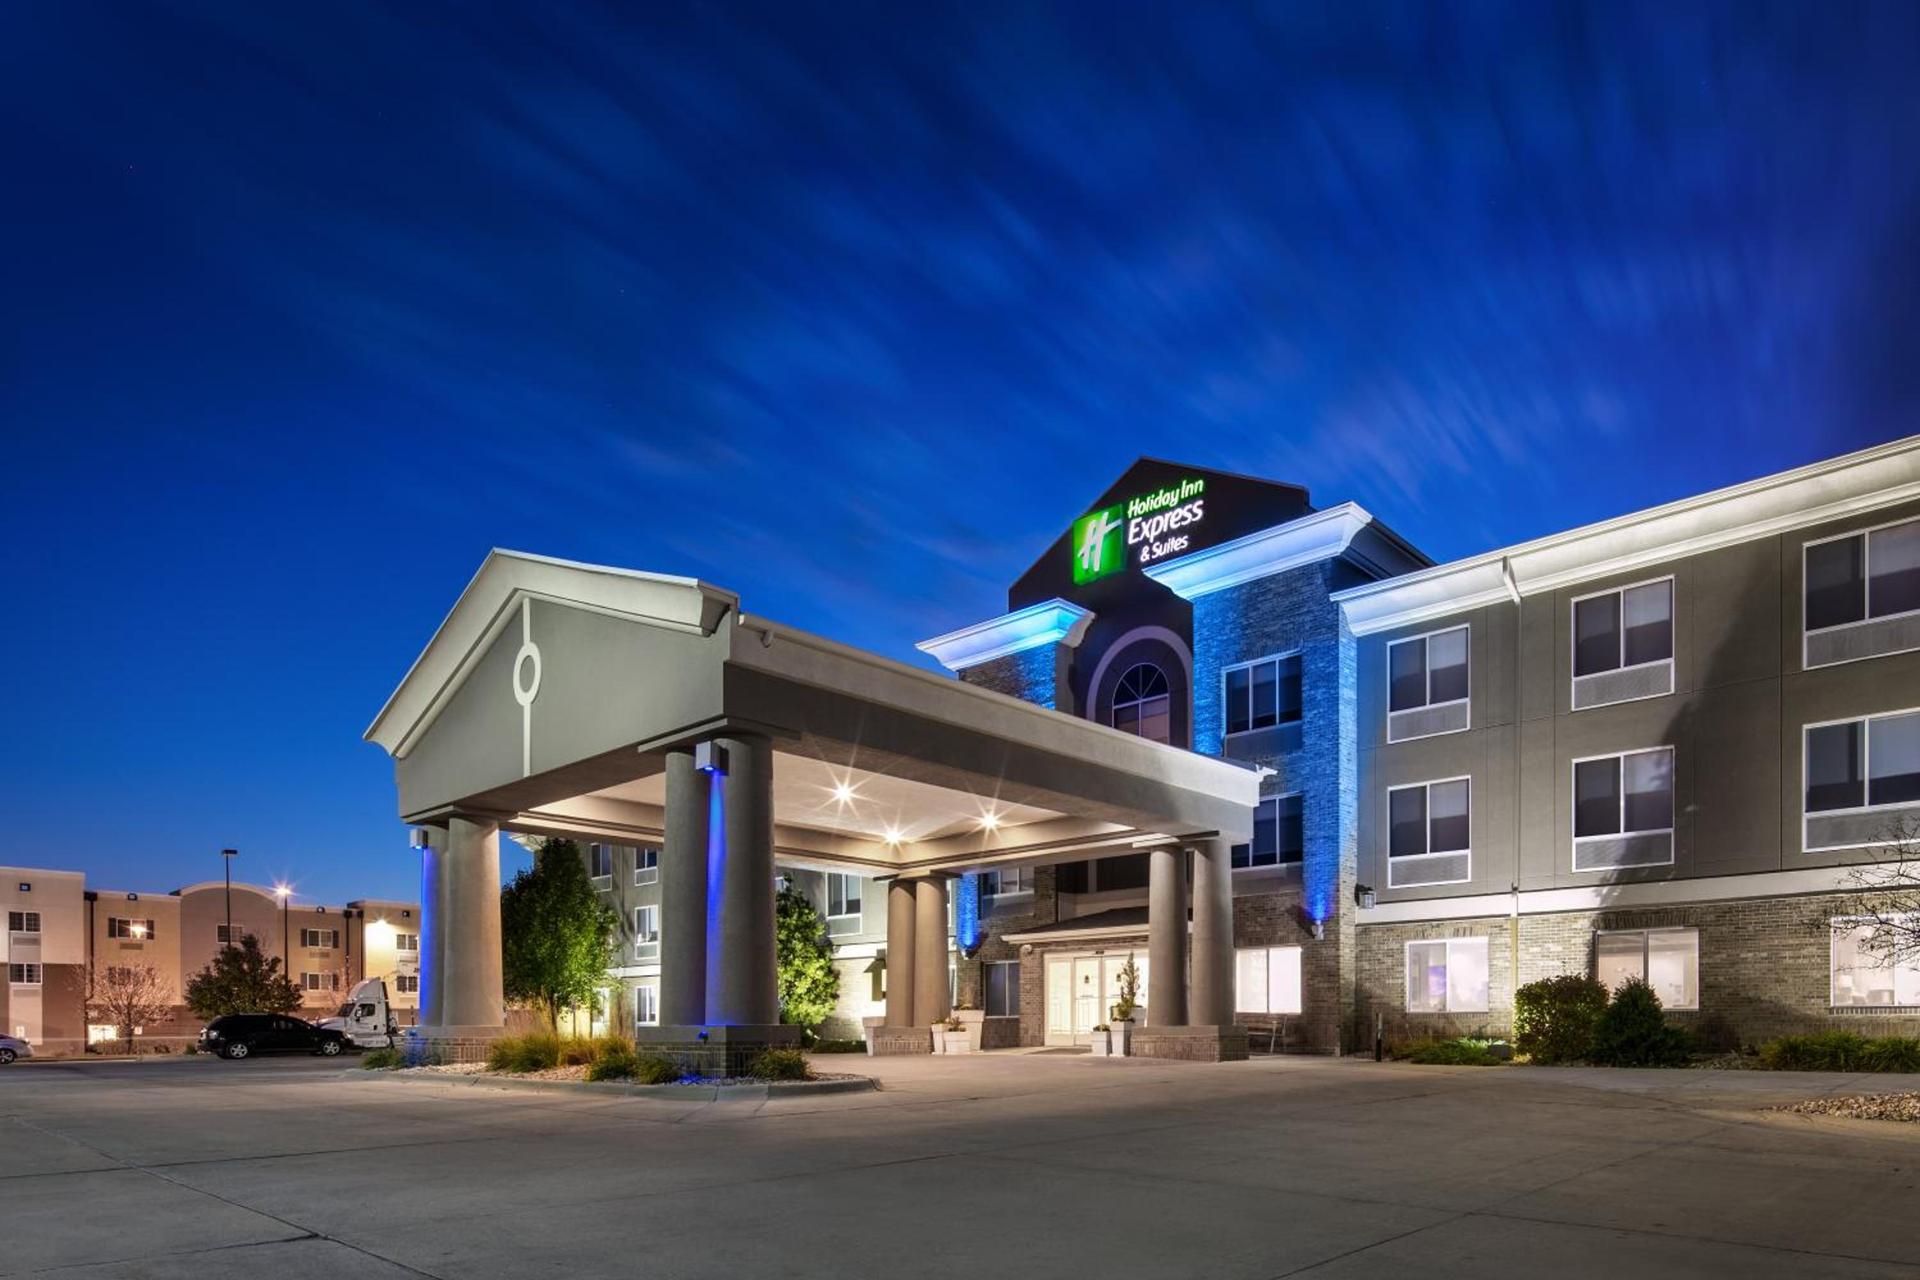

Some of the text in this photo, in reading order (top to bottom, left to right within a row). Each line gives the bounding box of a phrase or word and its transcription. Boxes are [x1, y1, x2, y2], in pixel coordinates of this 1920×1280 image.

[1127, 479, 1204, 518] Holiday Inn
[1127, 500, 1204, 545] Express
[1140, 535, 1188, 562] & Suites
